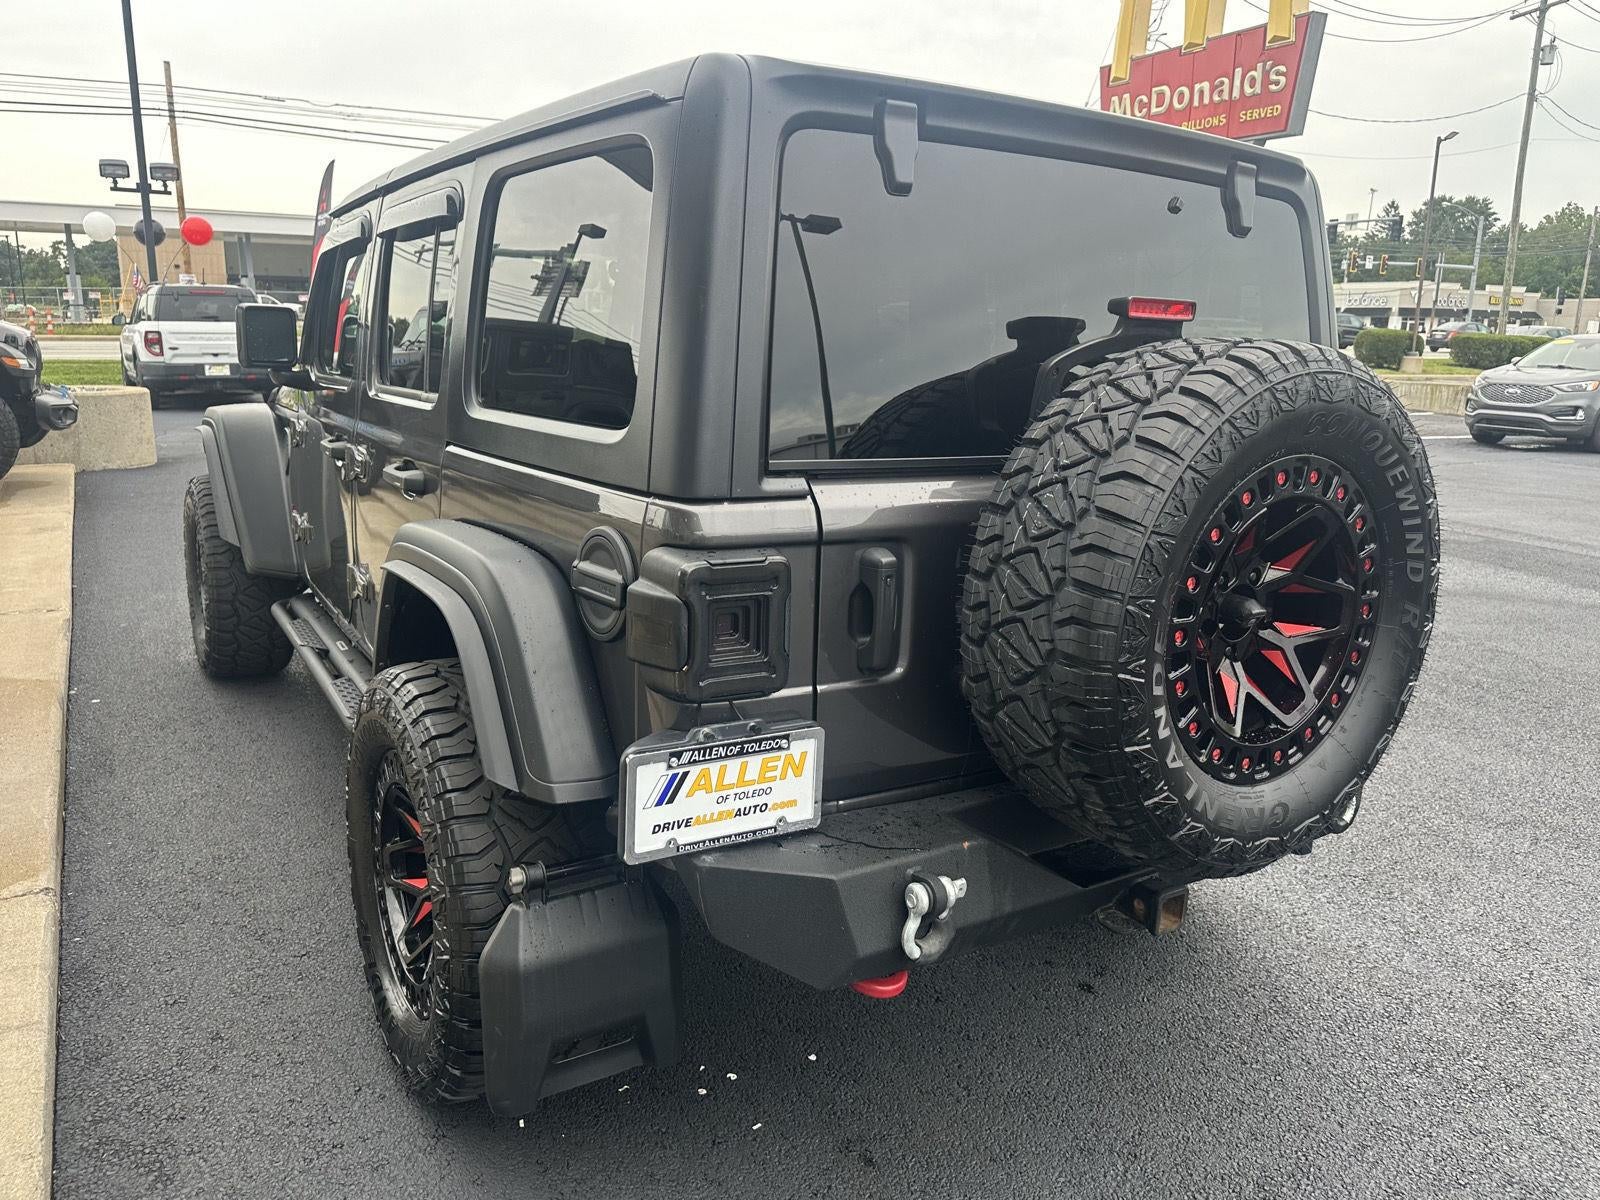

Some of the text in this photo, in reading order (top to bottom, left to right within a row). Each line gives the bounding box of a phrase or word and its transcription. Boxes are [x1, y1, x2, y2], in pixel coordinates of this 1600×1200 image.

[1109, 60, 1288, 118] McDonald's
[1239, 104, 1281, 122] SERVED
[1303, 410, 1426, 584] CONQUEWIND
[727, 743, 741, 756] OF
[743, 738, 781, 754] TOLEDO
[686, 751, 808, 798] ALLEN
[716, 786, 773, 805] OF TOLEDO
[651, 798, 798, 835] DRIVEALLENAUTO.com
